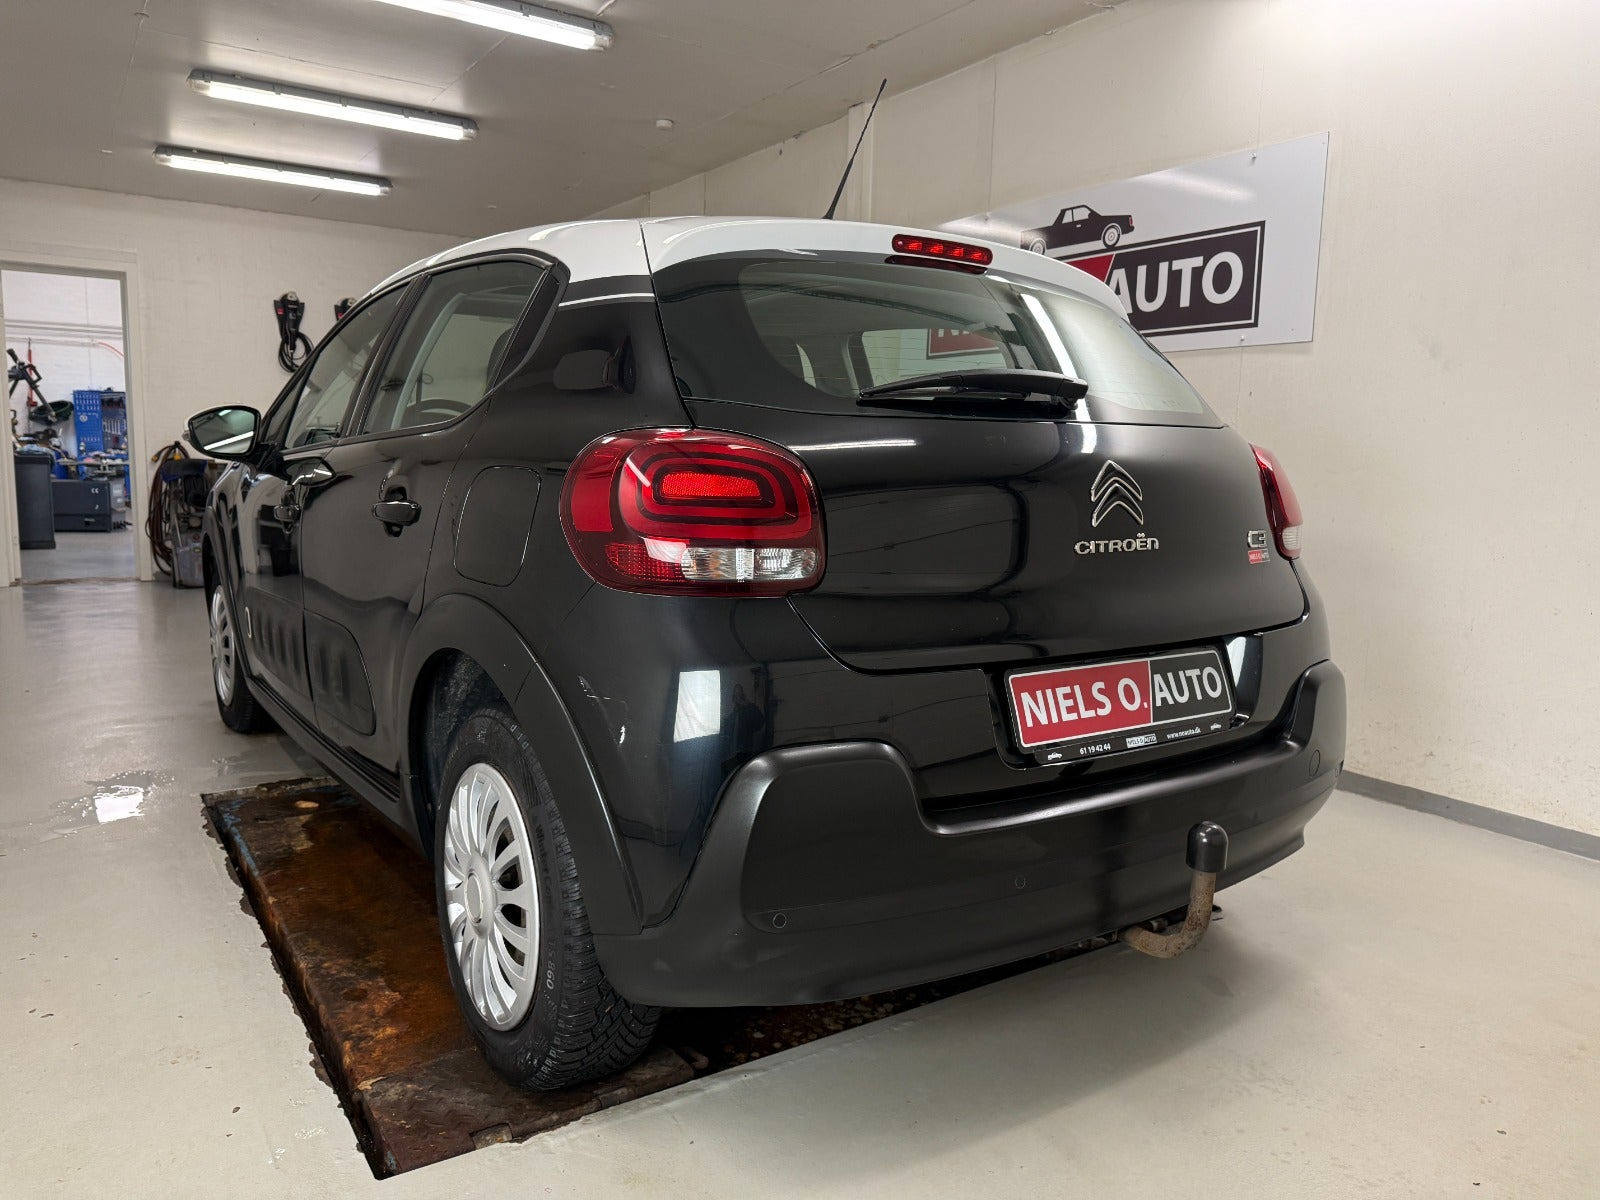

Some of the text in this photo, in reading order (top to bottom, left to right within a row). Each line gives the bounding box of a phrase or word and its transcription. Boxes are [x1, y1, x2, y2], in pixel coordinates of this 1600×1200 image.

[1104, 251, 1244, 315] AUTO
[1247, 530, 1268, 548] C3
[1020, 665, 1222, 728] NIELS O. AUTO
[1088, 745, 1096, 753] 19
[1096, 744, 1104, 752] 42
[1104, 742, 1111, 750] 44
